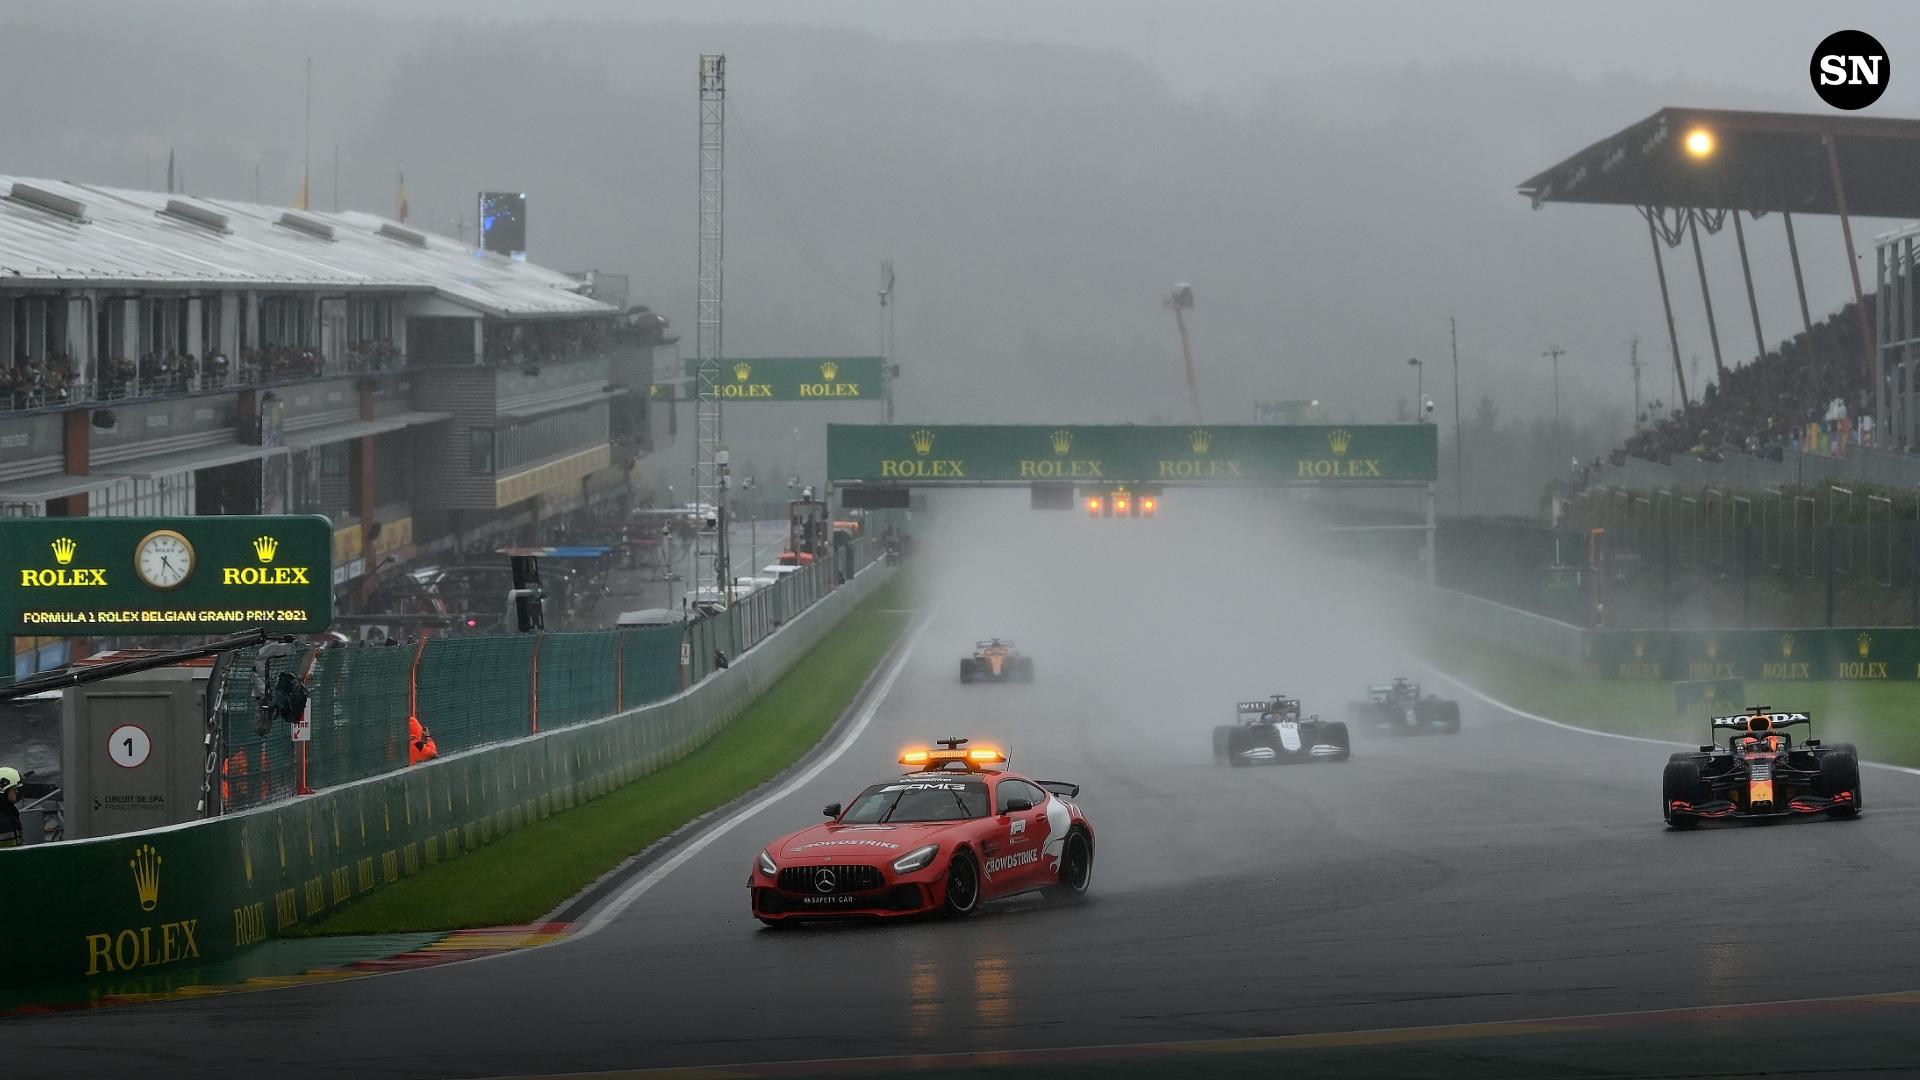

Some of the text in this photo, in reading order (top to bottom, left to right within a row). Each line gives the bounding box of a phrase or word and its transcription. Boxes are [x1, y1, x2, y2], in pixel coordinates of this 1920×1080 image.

[713, 384, 772, 397] ROLEX
[800, 384, 859, 396] ROLEX
[881, 460, 964, 477] ROLEX
[1020, 460, 1102, 477] ROLEX
[1159, 460, 1241, 477] ROLEX
[1298, 460, 1380, 477] ROLEX
[21, 569, 107, 586] ROLEX
[223, 568, 309, 584] ROLEX
[23, 610, 307, 623] FORMULA 1 ROLEX BELGIAN GRAND PRIX 2021
[1763, 662, 1809, 678] ROLEX
[1840, 662, 1887, 678] ROLEX
[1714, 713, 1808, 725] HODA
[123, 738, 133, 756] 1
[1010, 819, 1026, 835] F1
[984, 849, 1037, 873] CROWDSTRIKE
[234, 902, 266, 946] ROLEX
[86, 919, 200, 976] ROLEX
